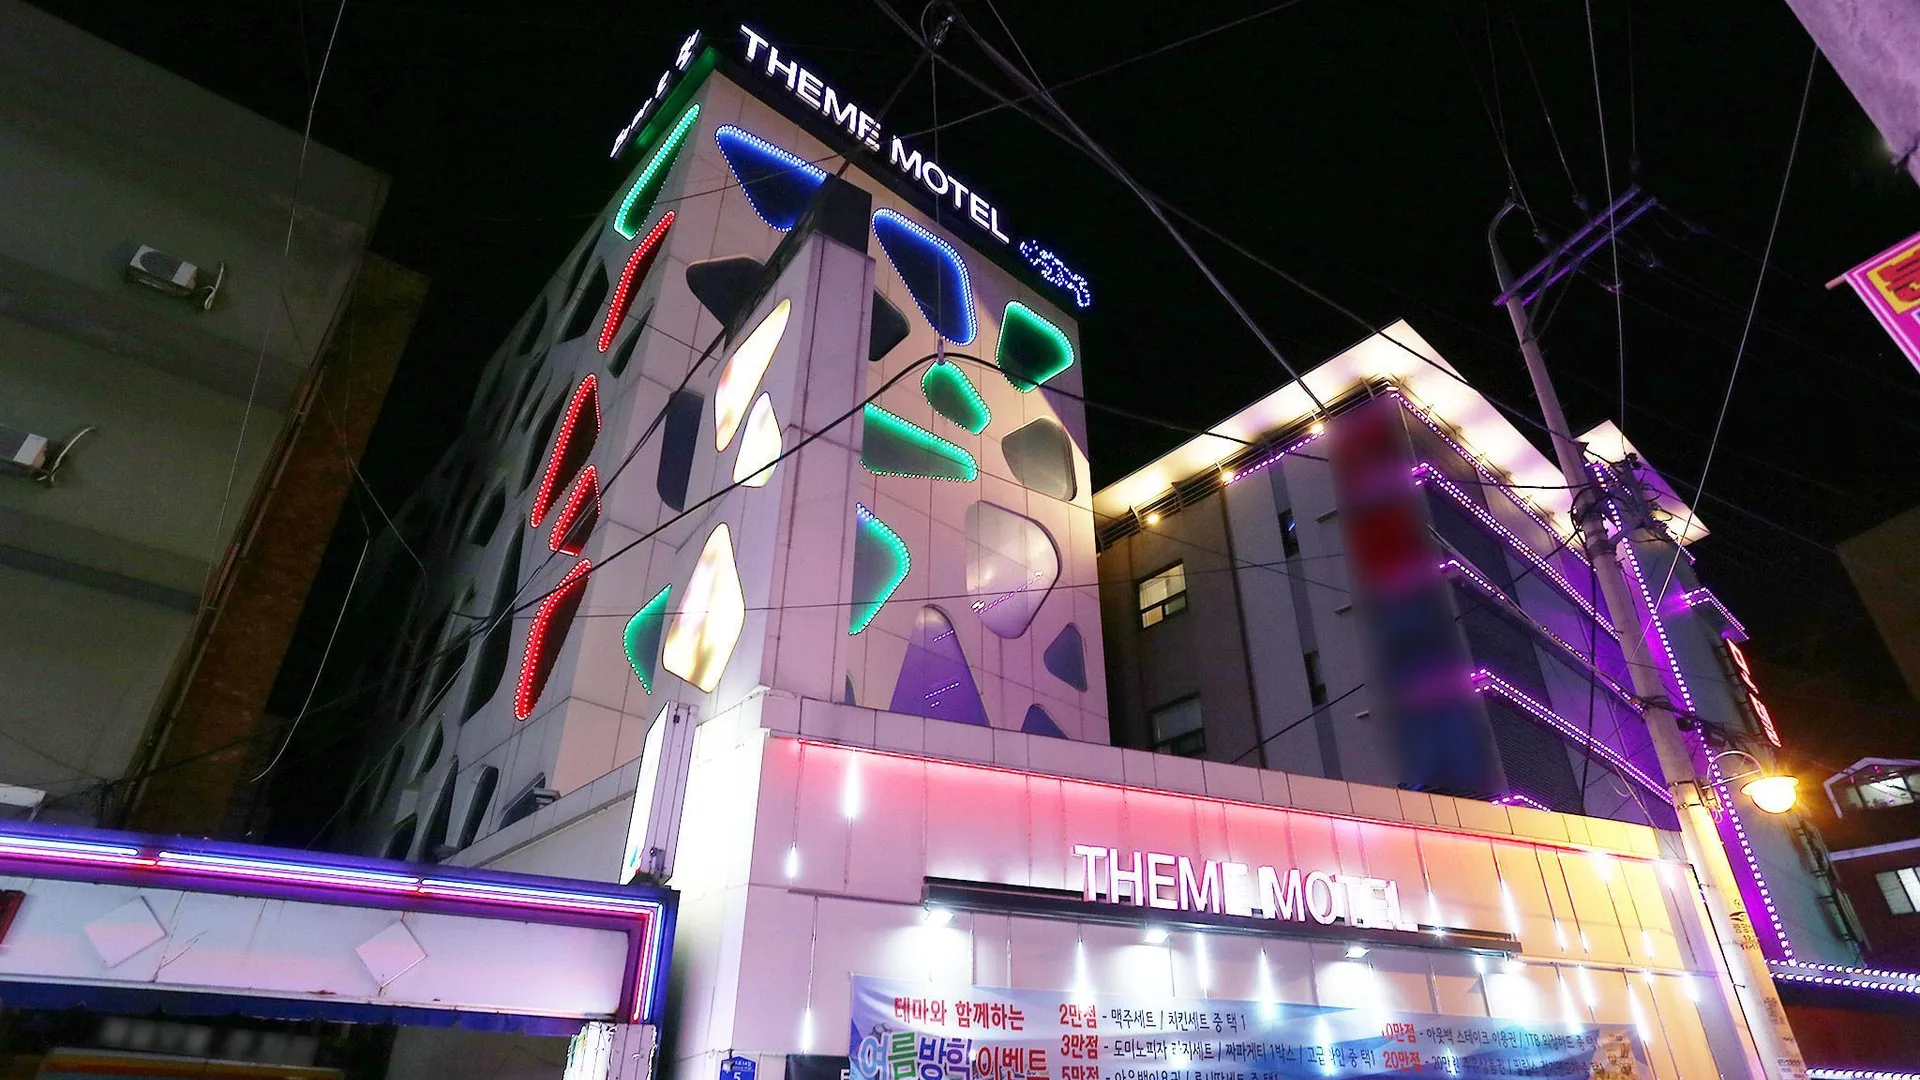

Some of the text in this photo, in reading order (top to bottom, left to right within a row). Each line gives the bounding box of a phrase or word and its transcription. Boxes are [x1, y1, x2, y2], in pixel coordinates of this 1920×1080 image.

[740, 23, 881, 152] THEME
[890, 134, 1010, 245] MOTEL
[1073, 843, 1419, 933] THEME MOTEL
[893, 997, 1025, 1031] 테마와 함께하는
[1059, 1003, 1097, 1029] 2만점
[1111, 1008, 1157, 1029] 맥주세트
[1168, 1010, 1210, 1032] 치킨세트
[1060, 1034, 1098, 1060] 3만점
[1113, 1038, 1168, 1060] 도미노피자
[1225, 1041, 1267, 1062] 짜파게티
[1270, 1044, 1297, 1064] 1박스
[1426, 1026, 1454, 1045] 아웃백
[1457, 1028, 1491, 1045] 스테이크
[1492, 1029, 1518, 1049] 이용권
[1525, 1032, 1541, 1047] 1TB
[858, 1031, 1050, 1080] 여름방학 이벤트
[1383, 1050, 1423, 1073] 20만점
